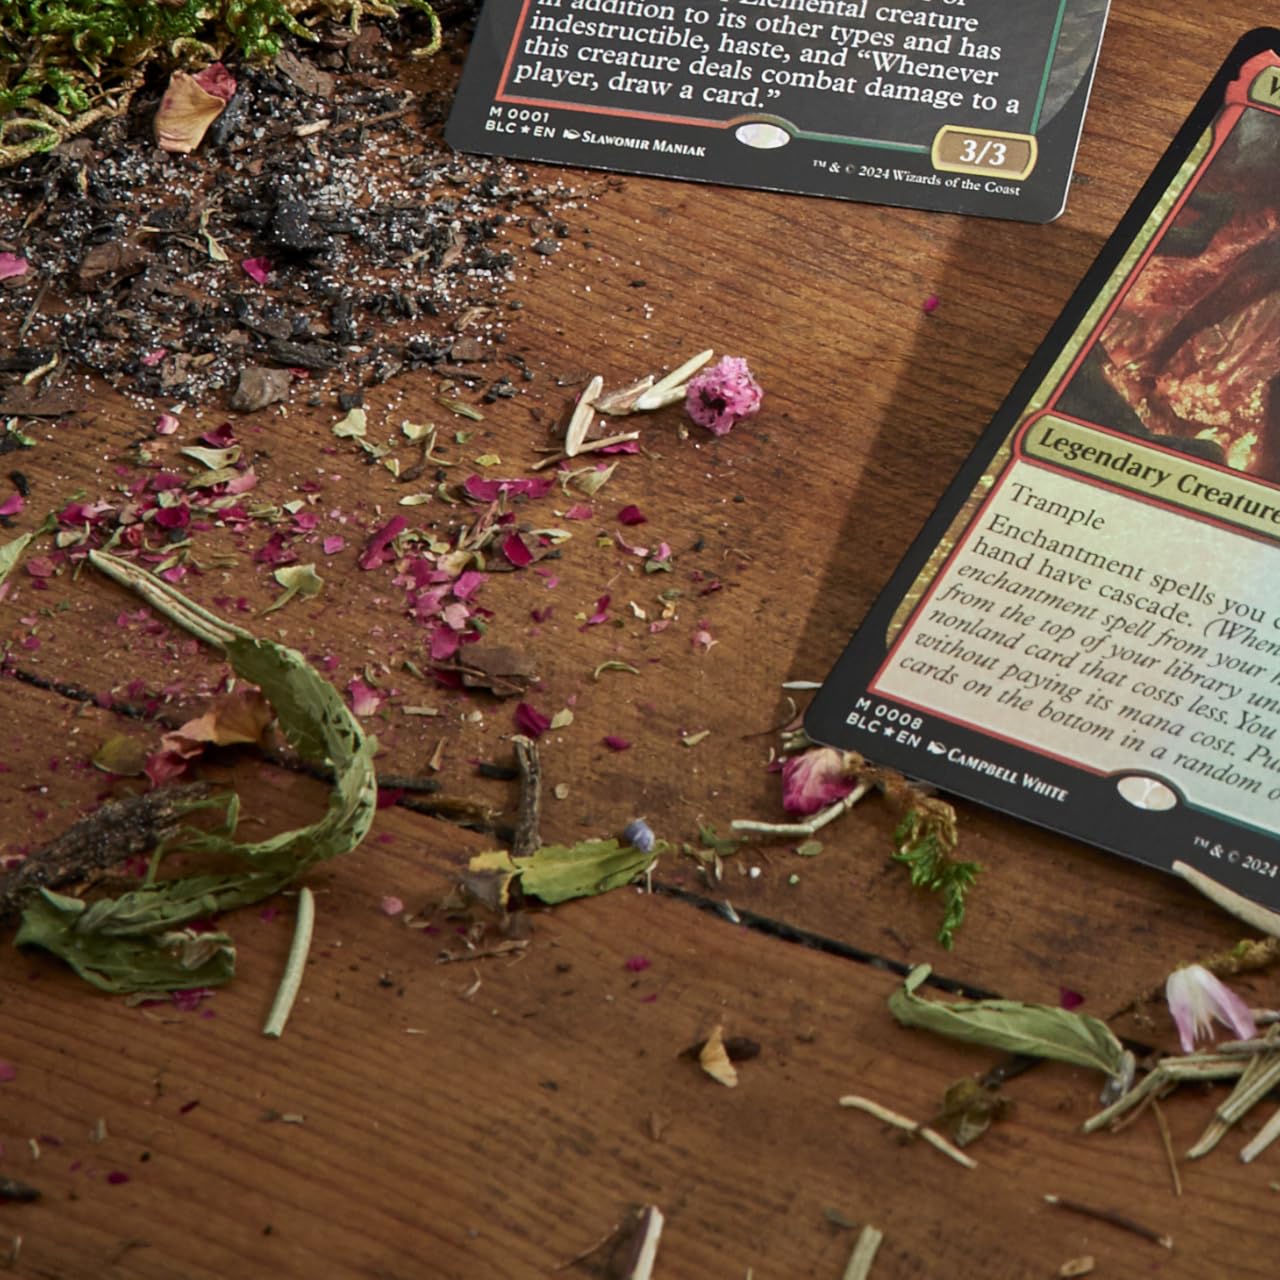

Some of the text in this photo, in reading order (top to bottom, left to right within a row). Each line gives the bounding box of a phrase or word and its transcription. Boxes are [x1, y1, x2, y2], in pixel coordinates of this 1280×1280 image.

[529, 8, 711, 54] indestructible,
[716, 31, 791, 64] haste,
[798, 46, 849, 67] and
[683, 6, 710, 25] to
[716, 6, 748, 30] its
[754, 13, 824, 39] other
[829, 24, 895, 49] types
[902, 33, 953, 55] and
[957, 35, 1002, 61] has
[874, 6, 980, 33] creature
[512, 60, 599, 92] player,
[607, 69, 673, 97] draw
[677, 83, 694, 100] a
[523, 34, 1020, 115] this creature deals combat damage to a
[488, 105, 550, 124] M 0001
[857, 164, 891, 180] 2024
[891, 168, 942, 186] Wizards
[943, 176, 961, 189] of
[960, 178, 982, 192] the
[983, 180, 1021, 197] Coast
[958, 138, 1007, 166] 3/3
[1038, 426, 1173, 488] Legendary
[1009, 481, 1106, 531] Trample
[970, 534, 1036, 572] hand
[1035, 557, 1093, 591] have
[1097, 583, 1193, 628] cascade.
[985, 512, 1145, 582] Enchantment
[1148, 573, 1216, 606] spells
[1216, 597, 1267, 624] you
[935, 581, 996, 614] from
[998, 603, 1037, 627] the
[1037, 618, 1076, 644] top
[1079, 633, 1113, 654] of
[1100, 643, 1162, 670] your
[1161, 657, 1243, 701] library
[956, 564, 1100, 621] enchantment
[1099, 613, 1157, 640] spell
[1146, 627, 1209, 660] from
[1205, 651, 1268, 678] your
[913, 632, 1001, 671] without
[996, 662, 1083, 704] paying
[1083, 687, 1114, 712] its
[1116, 704, 1186, 738] mana
[1188, 730, 1236, 757] cost.
[927, 609, 1027, 651] nonland
[1022, 643, 1081, 670] card
[1078, 659, 1129, 688] that
[1130, 681, 1185, 708] costs
[1186, 694, 1229, 726] less.
[1234, 708, 1278, 741] You
[854, 696, 924, 731] M 0008
[898, 656, 960, 686] cards
[961, 678, 993, 698] on
[995, 687, 1034, 712] the
[1036, 698, 1115, 742] bottom
[1118, 728, 1146, 753] in
[1148, 746, 1168, 761] a
[1171, 752, 1263, 795] random
[1240, 854, 1279, 879] 2024
